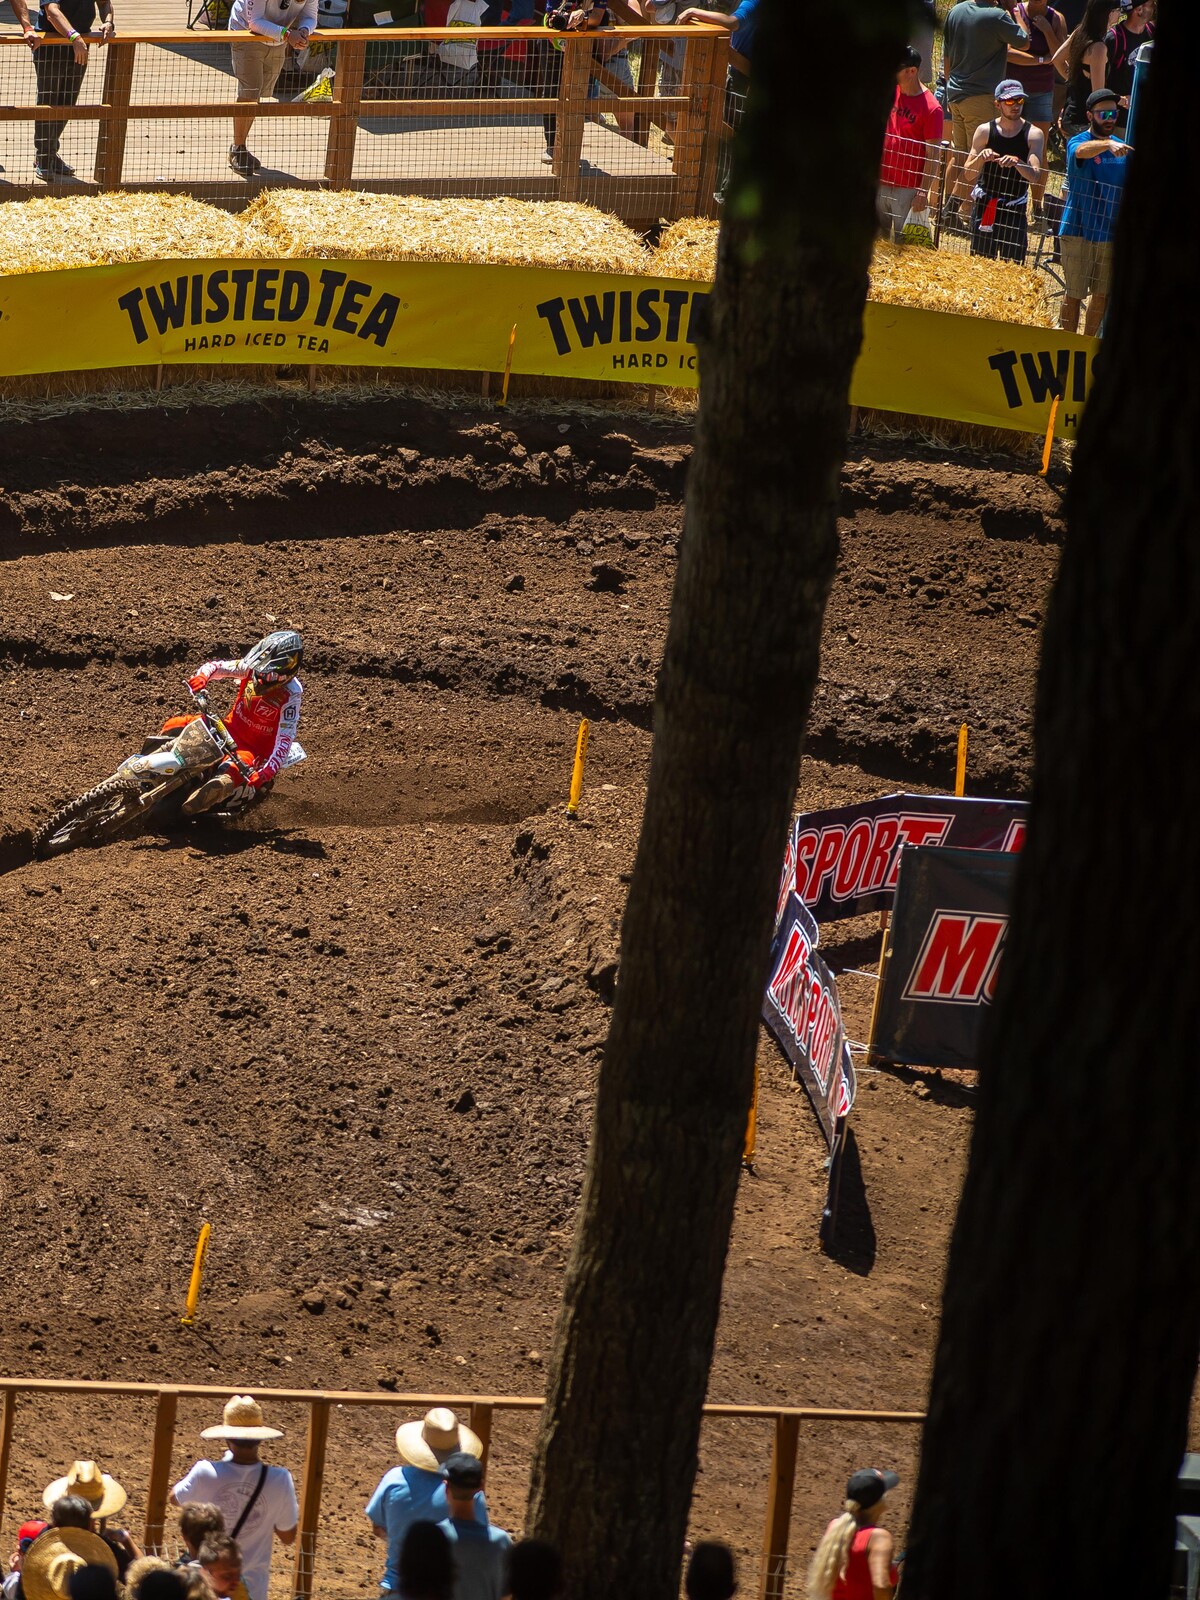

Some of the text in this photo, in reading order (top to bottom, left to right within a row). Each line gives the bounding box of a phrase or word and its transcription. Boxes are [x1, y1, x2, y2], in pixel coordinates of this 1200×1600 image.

[118, 269, 401, 348] TWISTED TEA
[536, 289, 711, 356] TWISTE
[184, 333, 330, 354] HARD ICED TEA
[612, 353, 668, 369] HARD
[988, 350, 1099, 409] TWI
